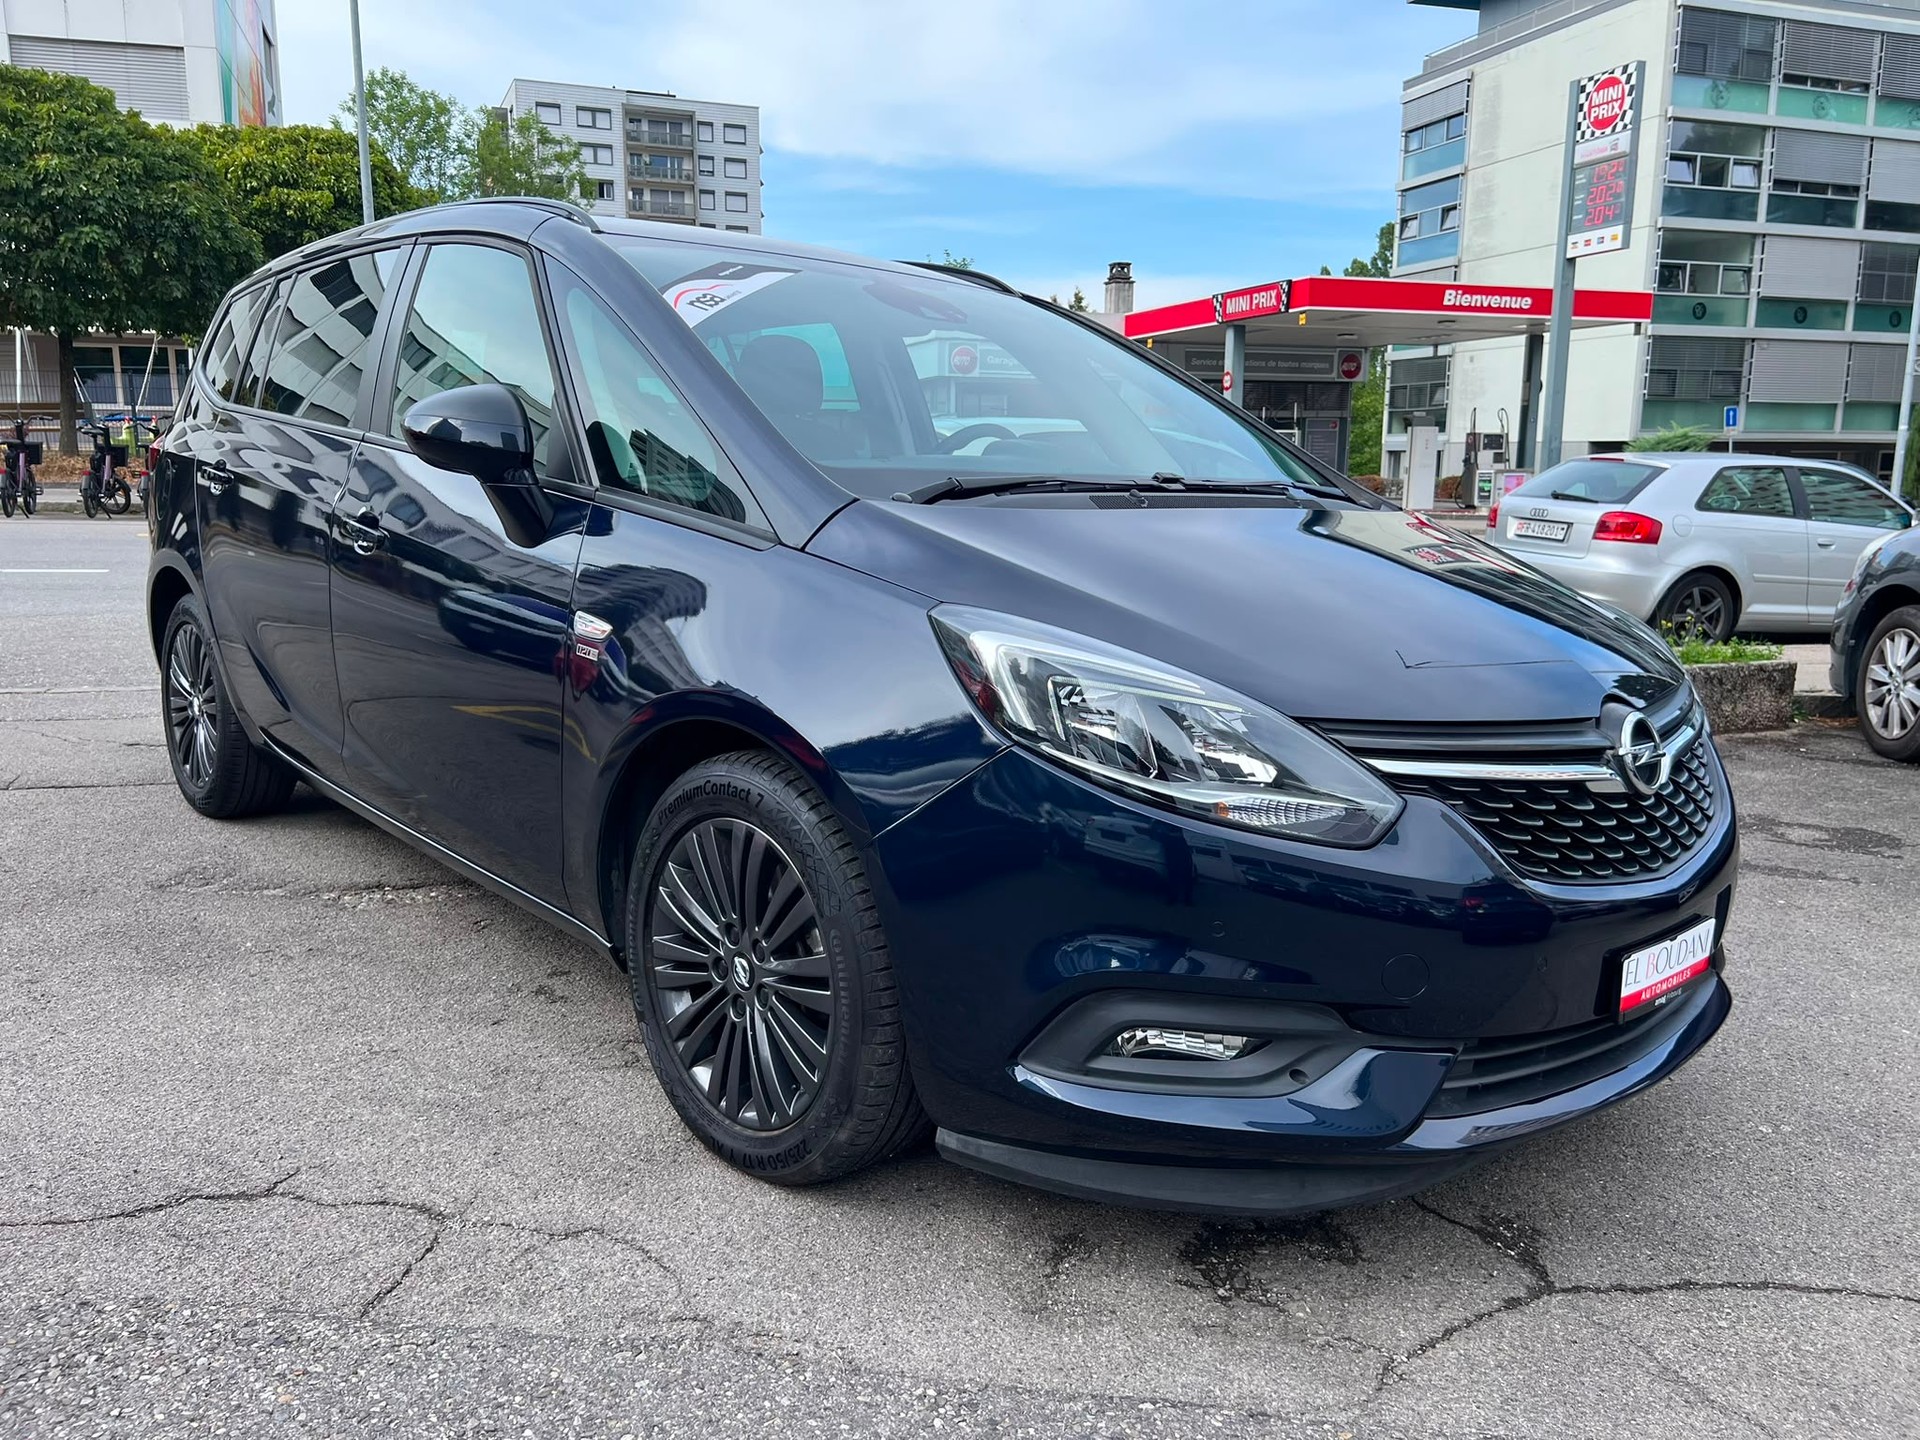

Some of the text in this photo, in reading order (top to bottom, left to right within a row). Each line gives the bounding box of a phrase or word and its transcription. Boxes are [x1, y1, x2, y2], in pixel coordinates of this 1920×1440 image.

[1592, 84, 1622, 105] MINI
[1590, 103, 1621, 123] PRIX
[1226, 289, 1278, 315] MINI PRIX
[1443, 289, 1532, 310] Bienvenue
[1267, 360, 1276, 368] de
[657, 780, 765, 825] PremiumContact 7
[1624, 957, 1641, 989] EL
[1641, 970, 1691, 1000] AUTOMOBILES
